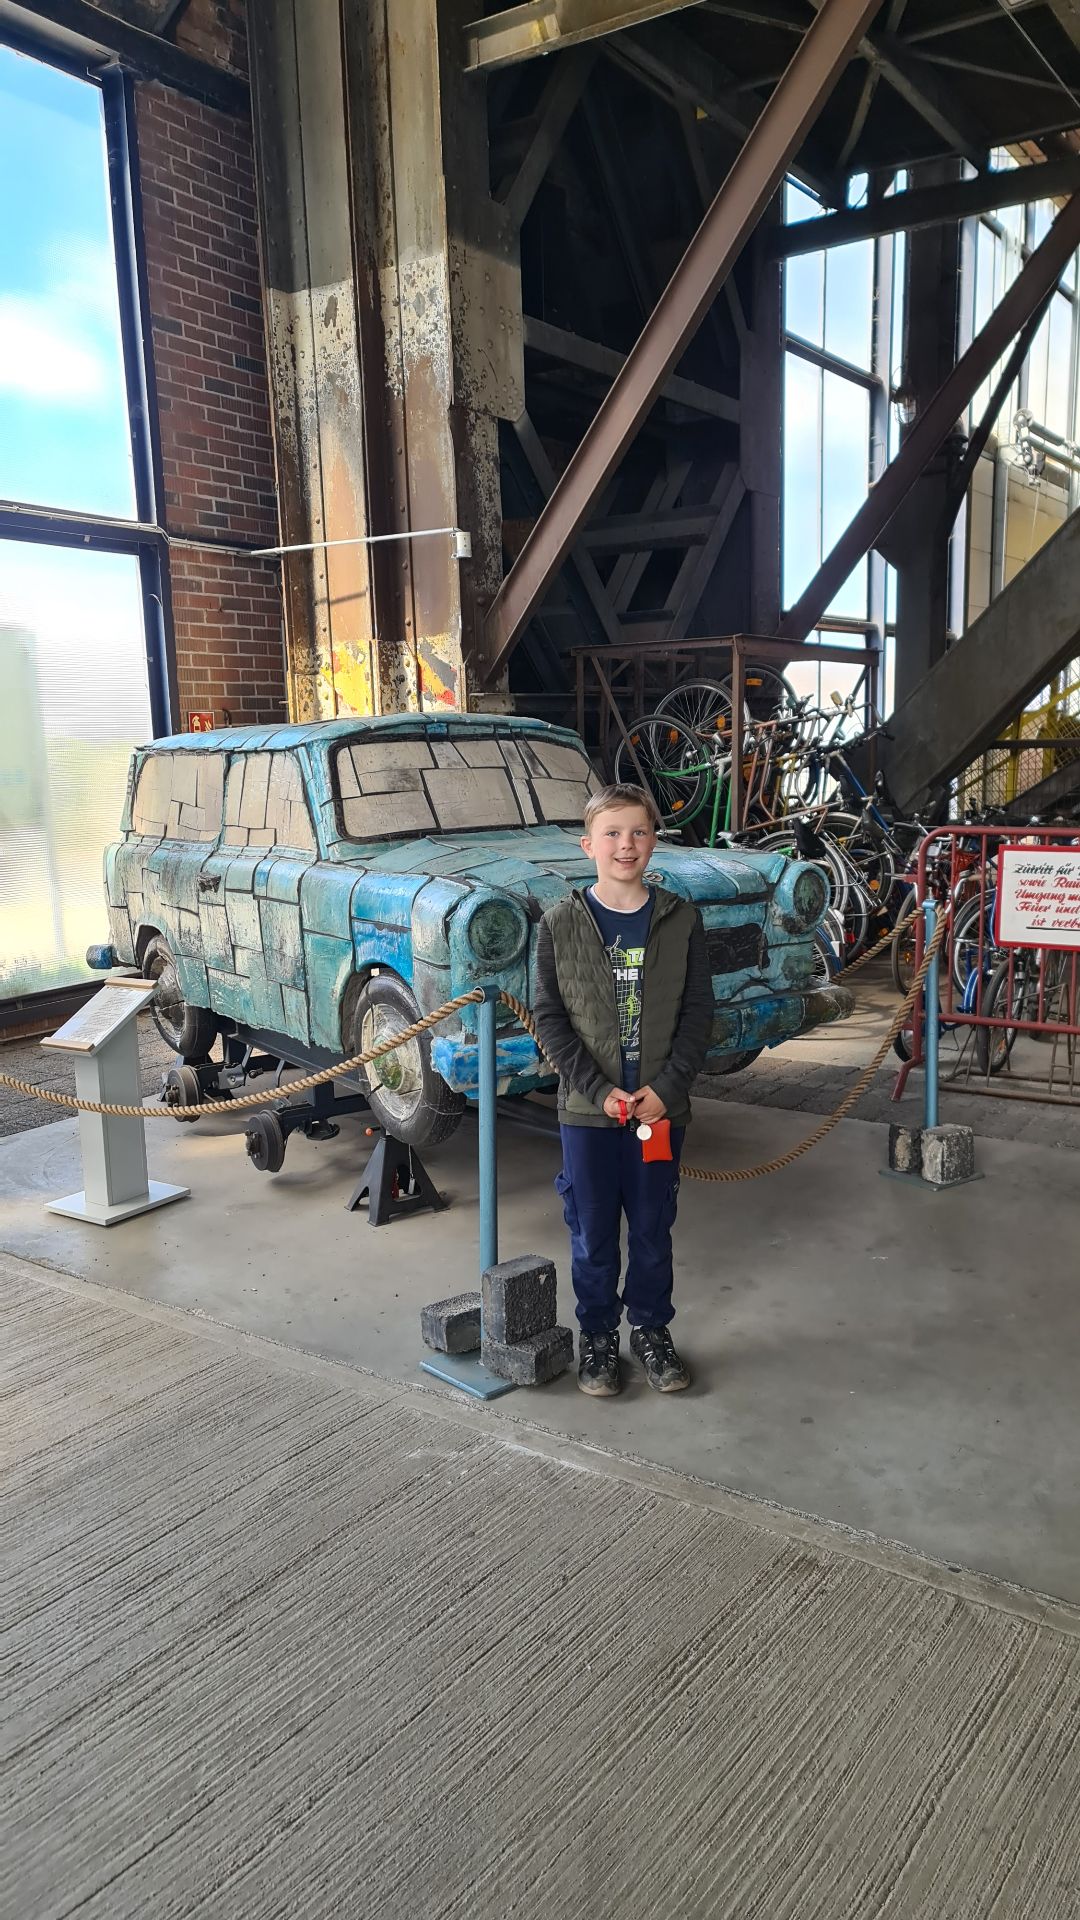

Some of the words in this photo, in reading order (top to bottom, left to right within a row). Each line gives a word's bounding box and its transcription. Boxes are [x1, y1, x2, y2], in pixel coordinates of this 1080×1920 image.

[1054, 862, 1075, 876] für
[1051, 876, 1080, 888] Rau
[1014, 889, 1066, 903] Umgang
[1031, 914, 1046, 926] ist
